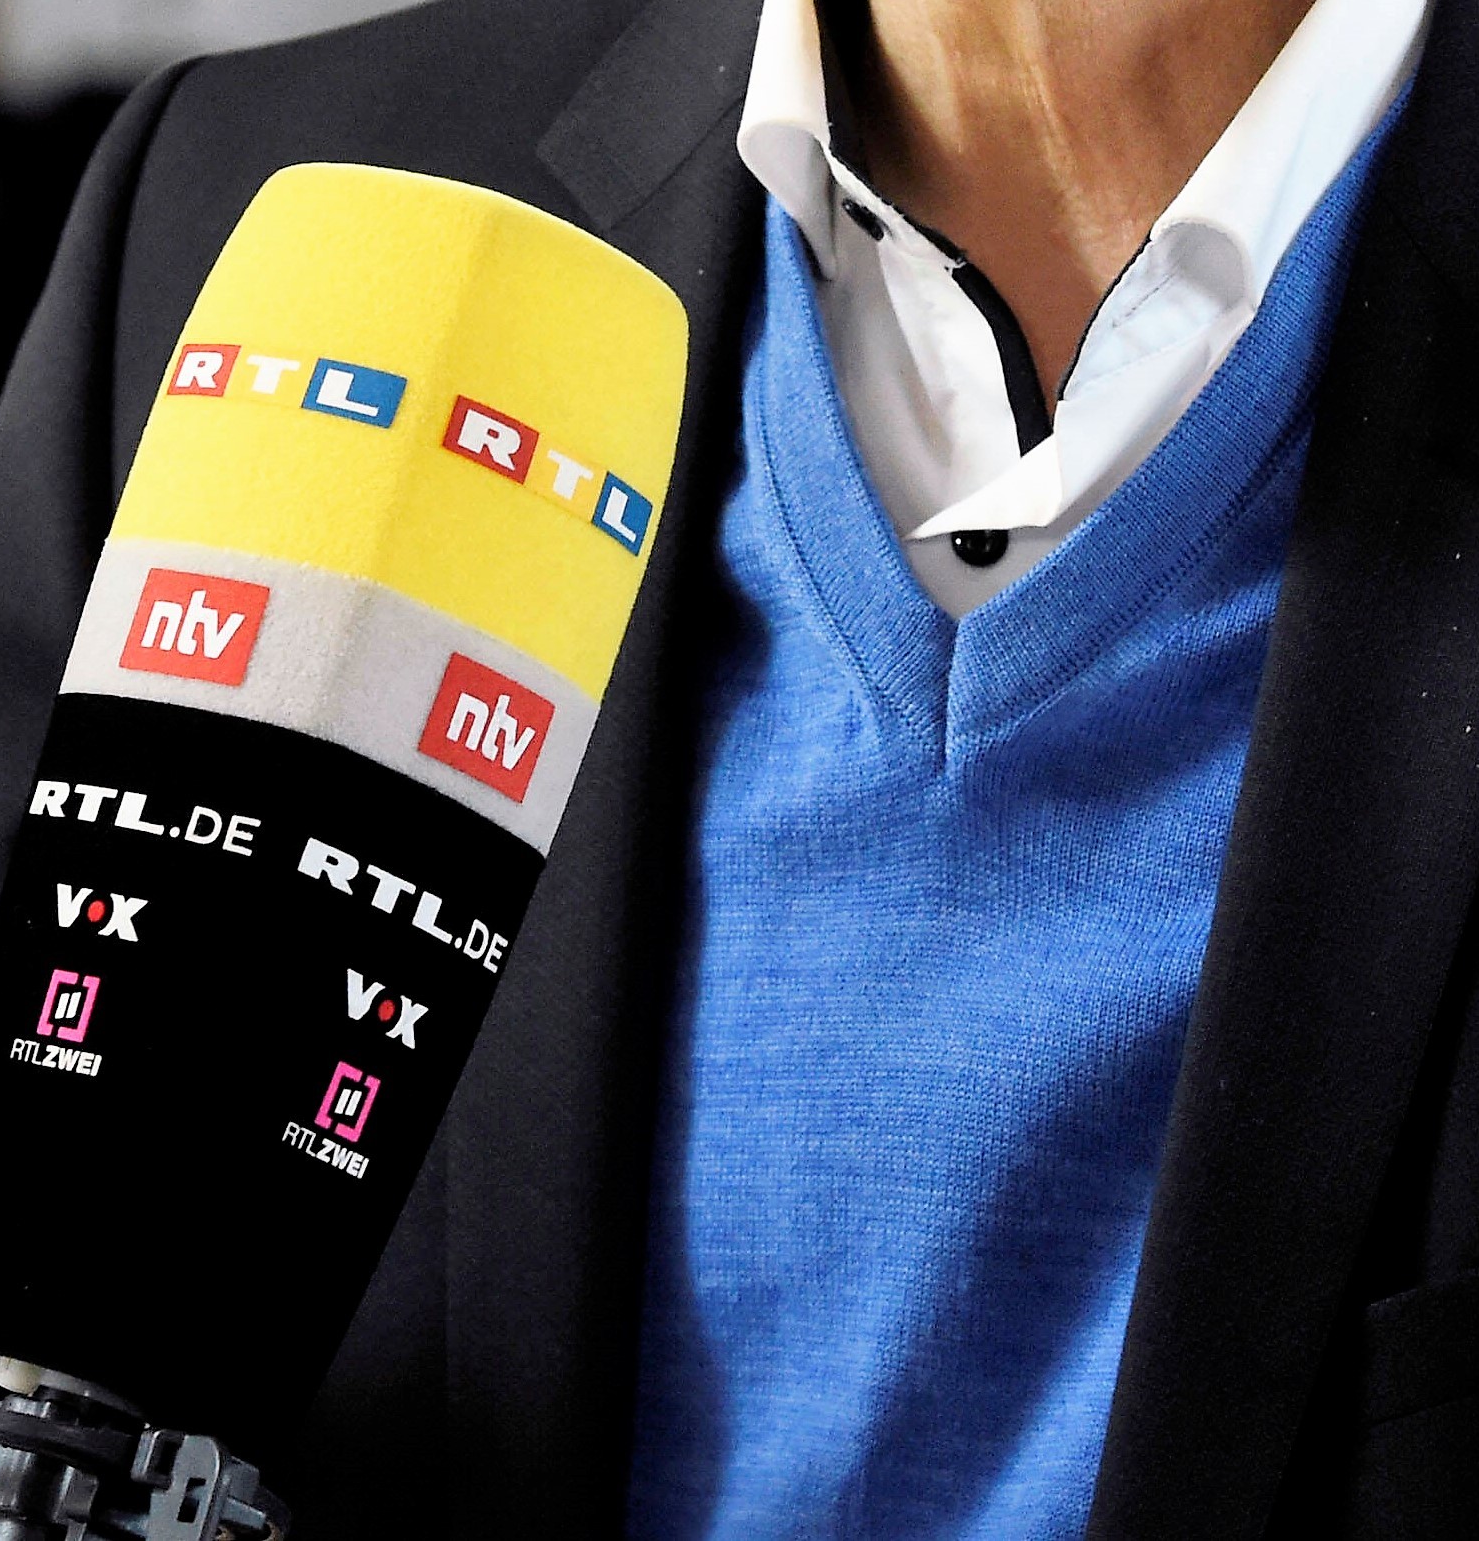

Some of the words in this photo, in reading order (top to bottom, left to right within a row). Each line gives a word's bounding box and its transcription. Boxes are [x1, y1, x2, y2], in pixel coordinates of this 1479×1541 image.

[174, 351, 379, 417] RTL
[457, 409, 637, 543] RTL
[140, 588, 246, 659] ntv
[446, 693, 536, 770] ntv
[29, 780, 261, 856] RTL.DE
[297, 837, 509, 974] RTL.DE
